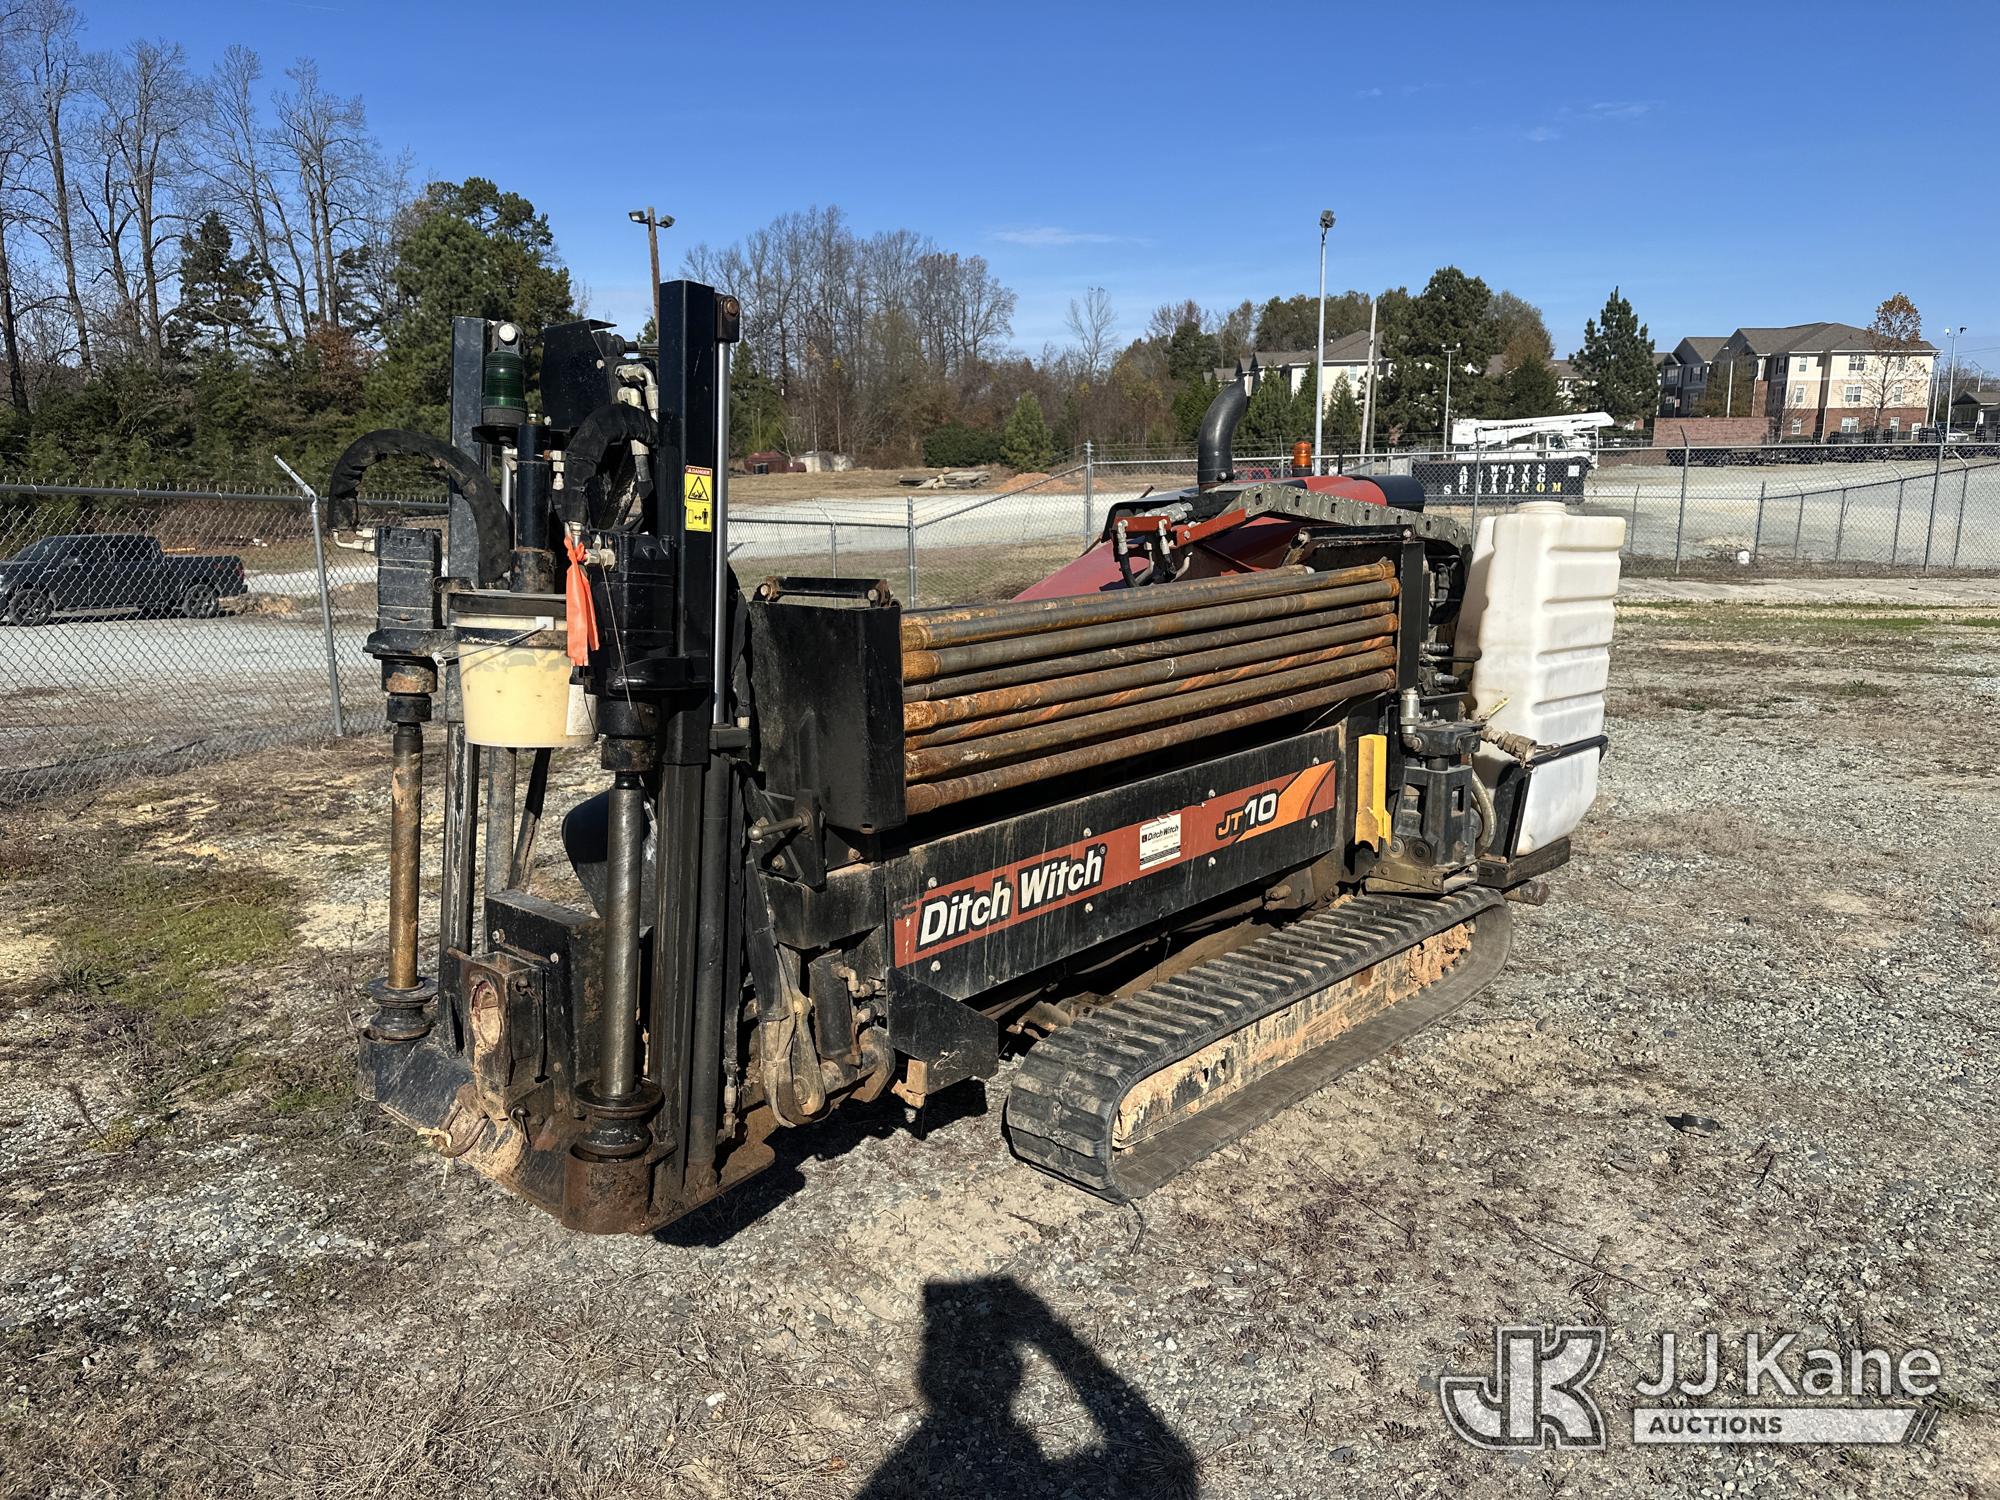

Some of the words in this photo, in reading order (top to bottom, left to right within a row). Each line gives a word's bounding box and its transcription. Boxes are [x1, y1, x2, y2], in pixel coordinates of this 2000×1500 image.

[1458, 464, 1546, 475] AWAYS
[1218, 793, 1277, 836] JT10
[1147, 828, 1164, 841] Ditch
[1163, 824, 1179, 836] Witch
[919, 880, 1012, 947] Ditch
